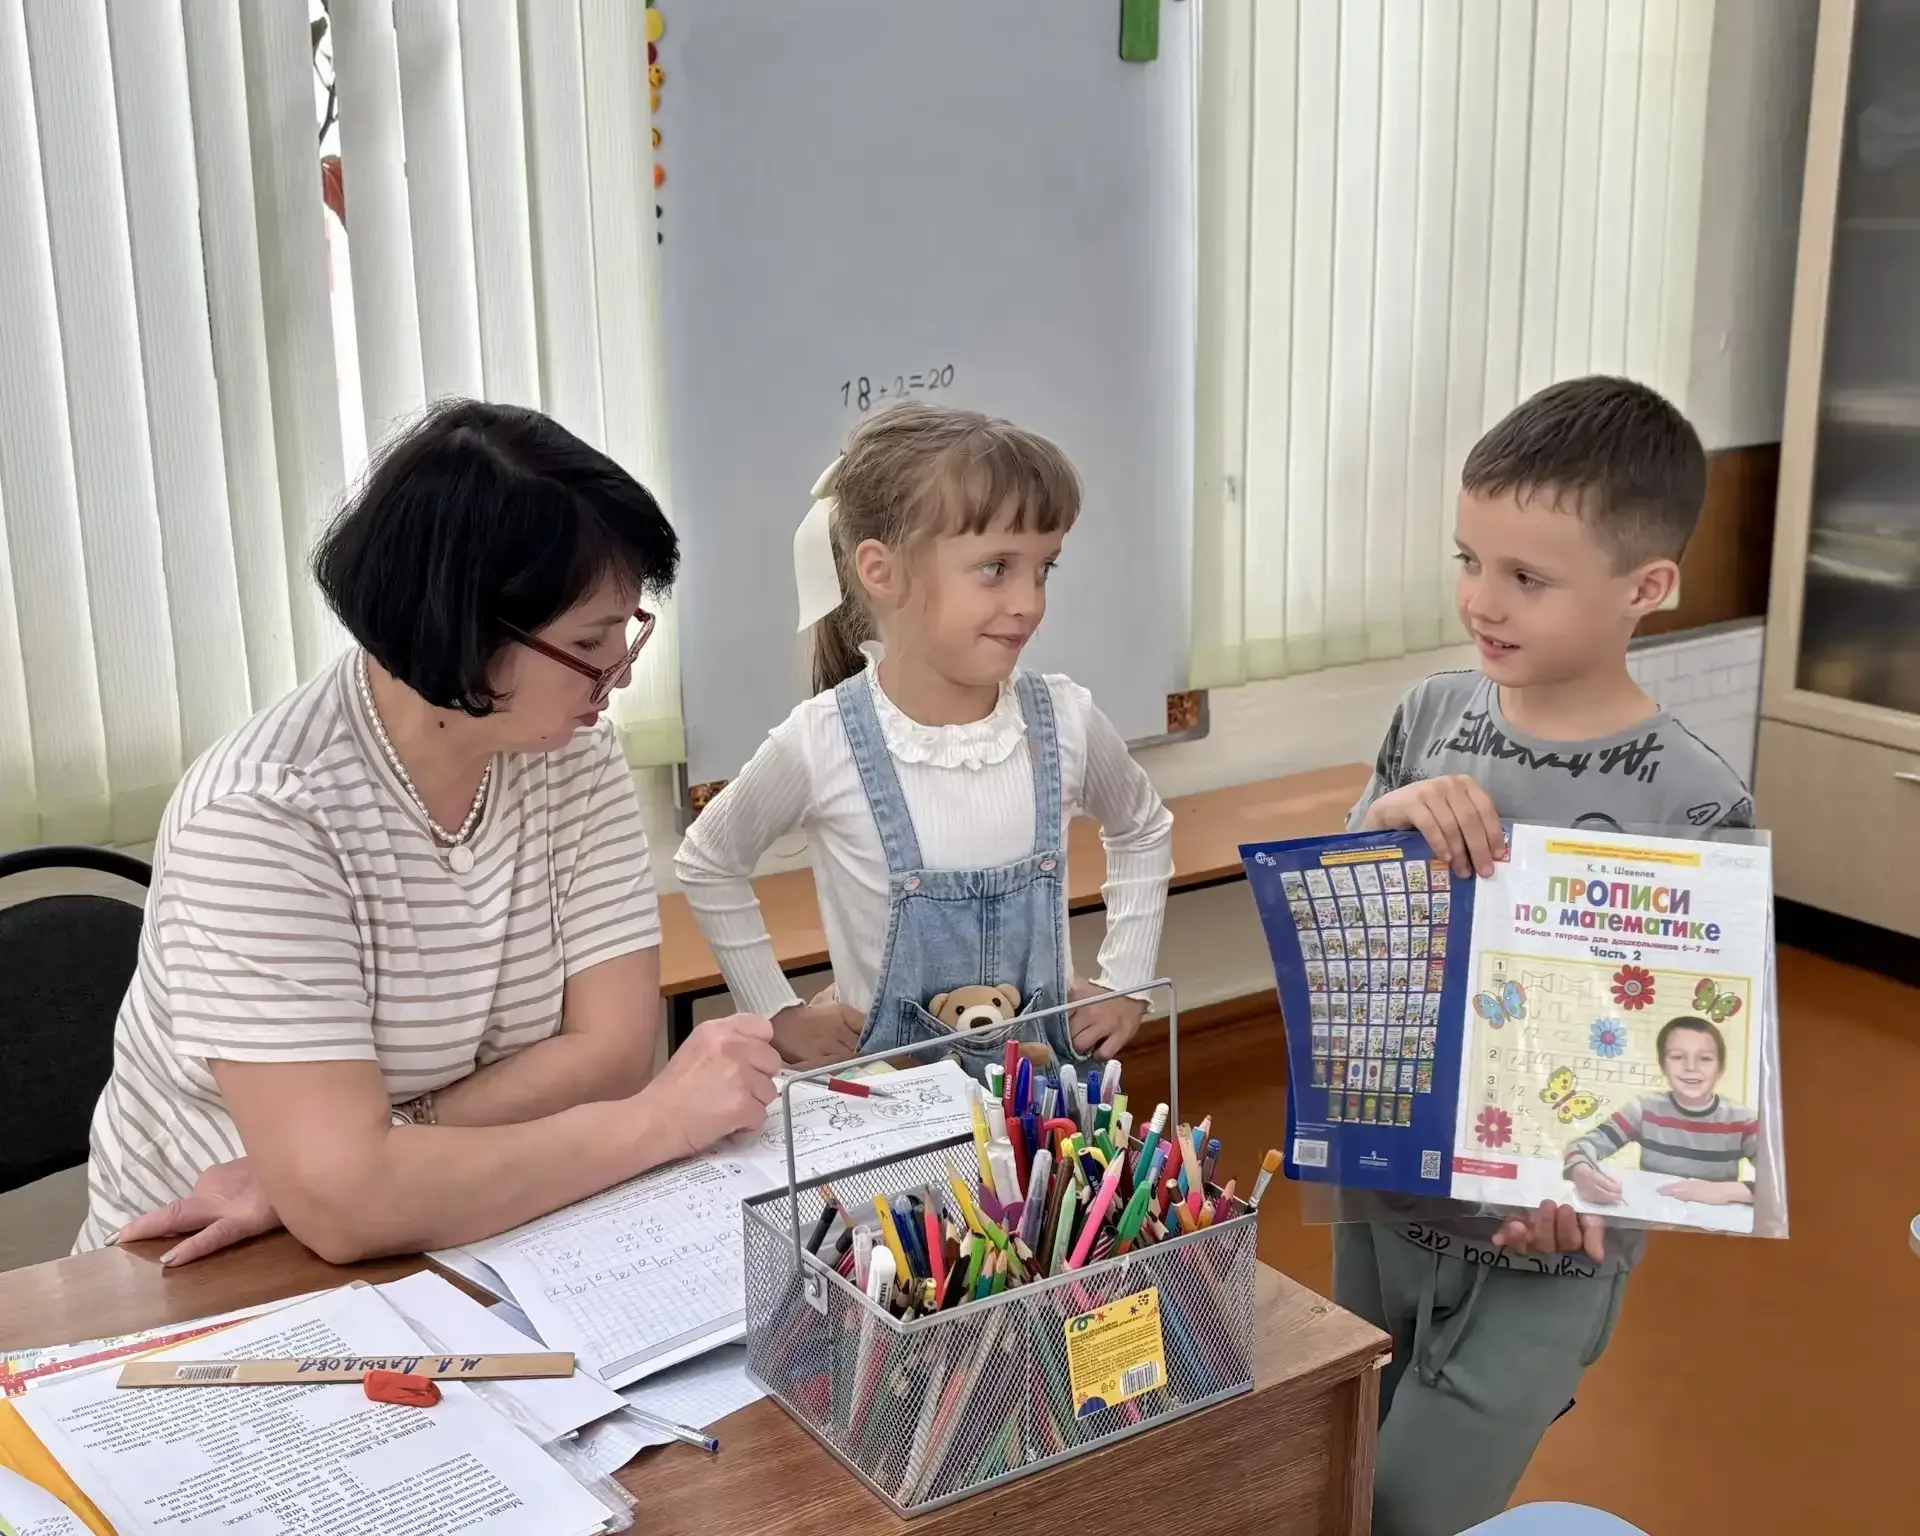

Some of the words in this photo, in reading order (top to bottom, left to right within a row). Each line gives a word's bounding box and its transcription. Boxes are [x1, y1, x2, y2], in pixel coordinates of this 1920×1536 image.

[1614, 865, 1656, 879] Шевелев
[1548, 876, 1692, 915] ПРОПИСИ
[1515, 903, 1547, 924] по
[1559, 908, 1721, 941] математике
[1514, 926, 1551, 939] Рабочая
[1555, 932, 1589, 944] тетрадь
[1592, 935, 1609, 945] для
[1612, 937, 1679, 952] дошкольников
[1703, 947, 1721, 956] лет
[1590, 945, 1627, 960] Часть
[1632, 950, 1642, 961] 2
[1489, 1050, 1498, 1059] 2
[1487, 1076, 1496, 1085] 3
[1408, 1222, 1451, 1250] are
[434, 1357, 453, 1373] А.
[460, 1357, 482, 1371] М.
